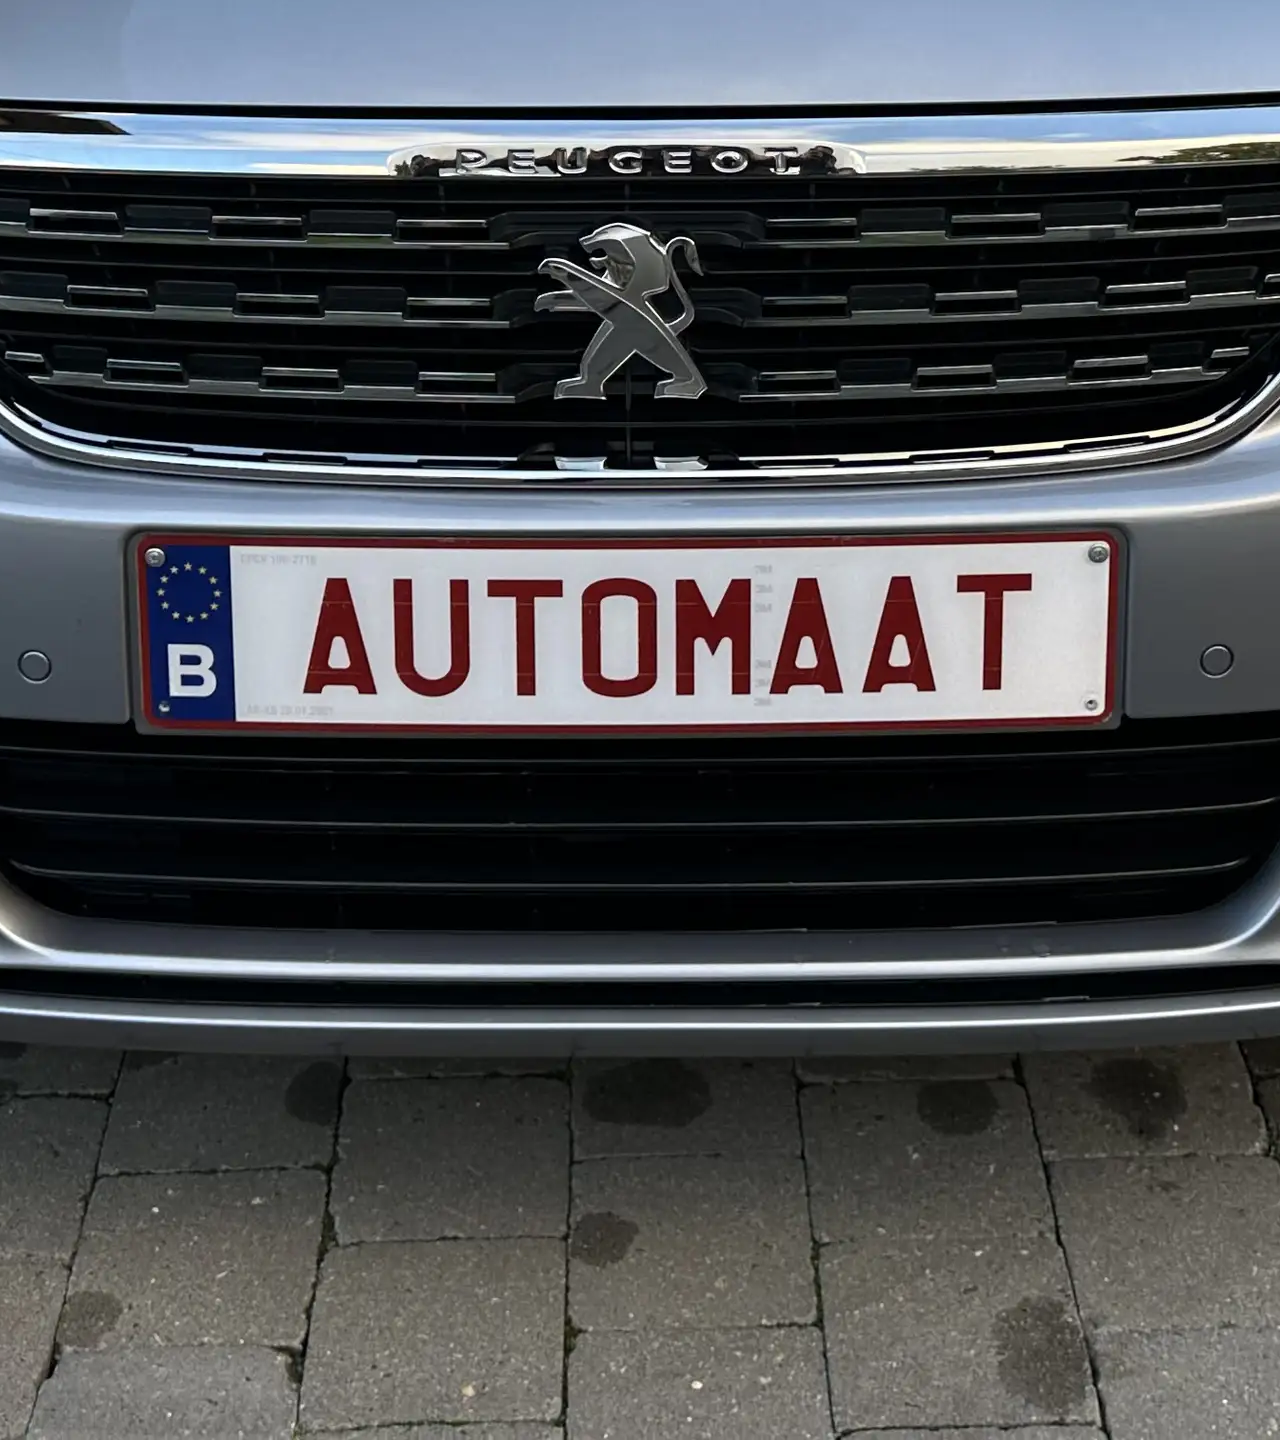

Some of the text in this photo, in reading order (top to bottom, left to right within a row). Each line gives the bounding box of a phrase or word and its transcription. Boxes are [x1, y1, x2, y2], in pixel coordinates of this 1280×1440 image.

[455, 148, 800, 174] PEUGEOT
[303, 573, 1034, 697] AUTOMAAT
[167, 643, 218, 697] B
